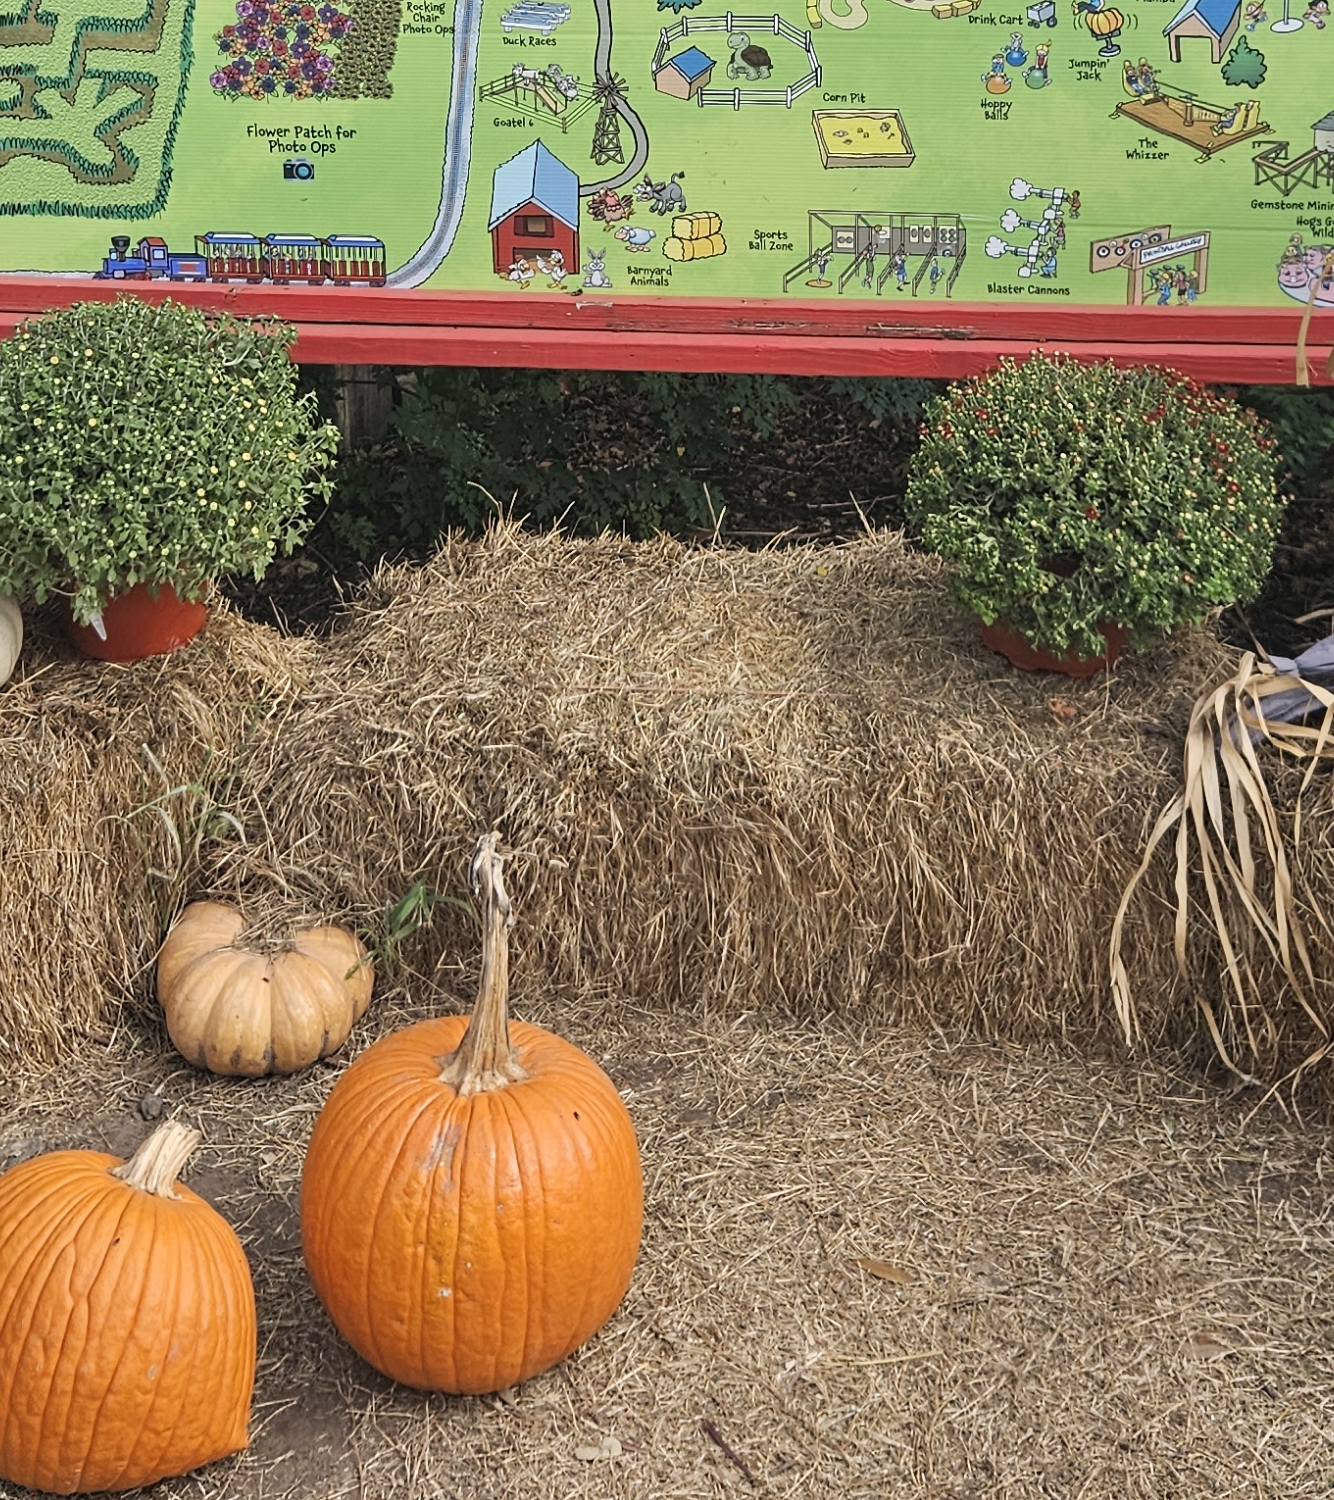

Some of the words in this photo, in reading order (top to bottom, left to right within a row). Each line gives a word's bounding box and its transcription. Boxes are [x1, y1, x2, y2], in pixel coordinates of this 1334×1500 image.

[407, 2, 445, 14] Rocking
[413, 12, 440, 23] Chair
[969, 14, 996, 25] Drink
[999, 14, 1023, 25] Cart
[403, 24, 432, 35] Photo
[435, 24, 454, 37] Ops
[503, 36, 526, 46] Duck
[529, 36, 556, 46] Races
[1069, 59, 1109, 71] Jumpin'
[1076, 70, 1101, 81] Jack
[823, 92, 847, 103] Corn
[850, 92, 865, 102] Pit
[981, 99, 1012, 112] Hoppy
[985, 110, 1008, 120] Balls
[247, 125, 290, 139] Flower
[295, 125, 332, 139] Patch
[336, 126, 356, 138] for
[269, 140, 307, 153] Photo
[311, 142, 336, 156] Ops
[1138, 138, 1158, 149] The
[1126, 149, 1169, 161] Whizzer
[1251, 200, 1304, 210] Gemstone
[754, 230, 788, 241] Sports
[1313, 227, 1334, 238] Wild
[749, 240, 766, 250] Ball
[769, 240, 794, 251] Zone
[627, 265, 672, 278] Barnyard
[631, 276, 669, 287] Animals
[988, 284, 1024, 295] Blaster
[1027, 285, 1070, 296] Cannons
